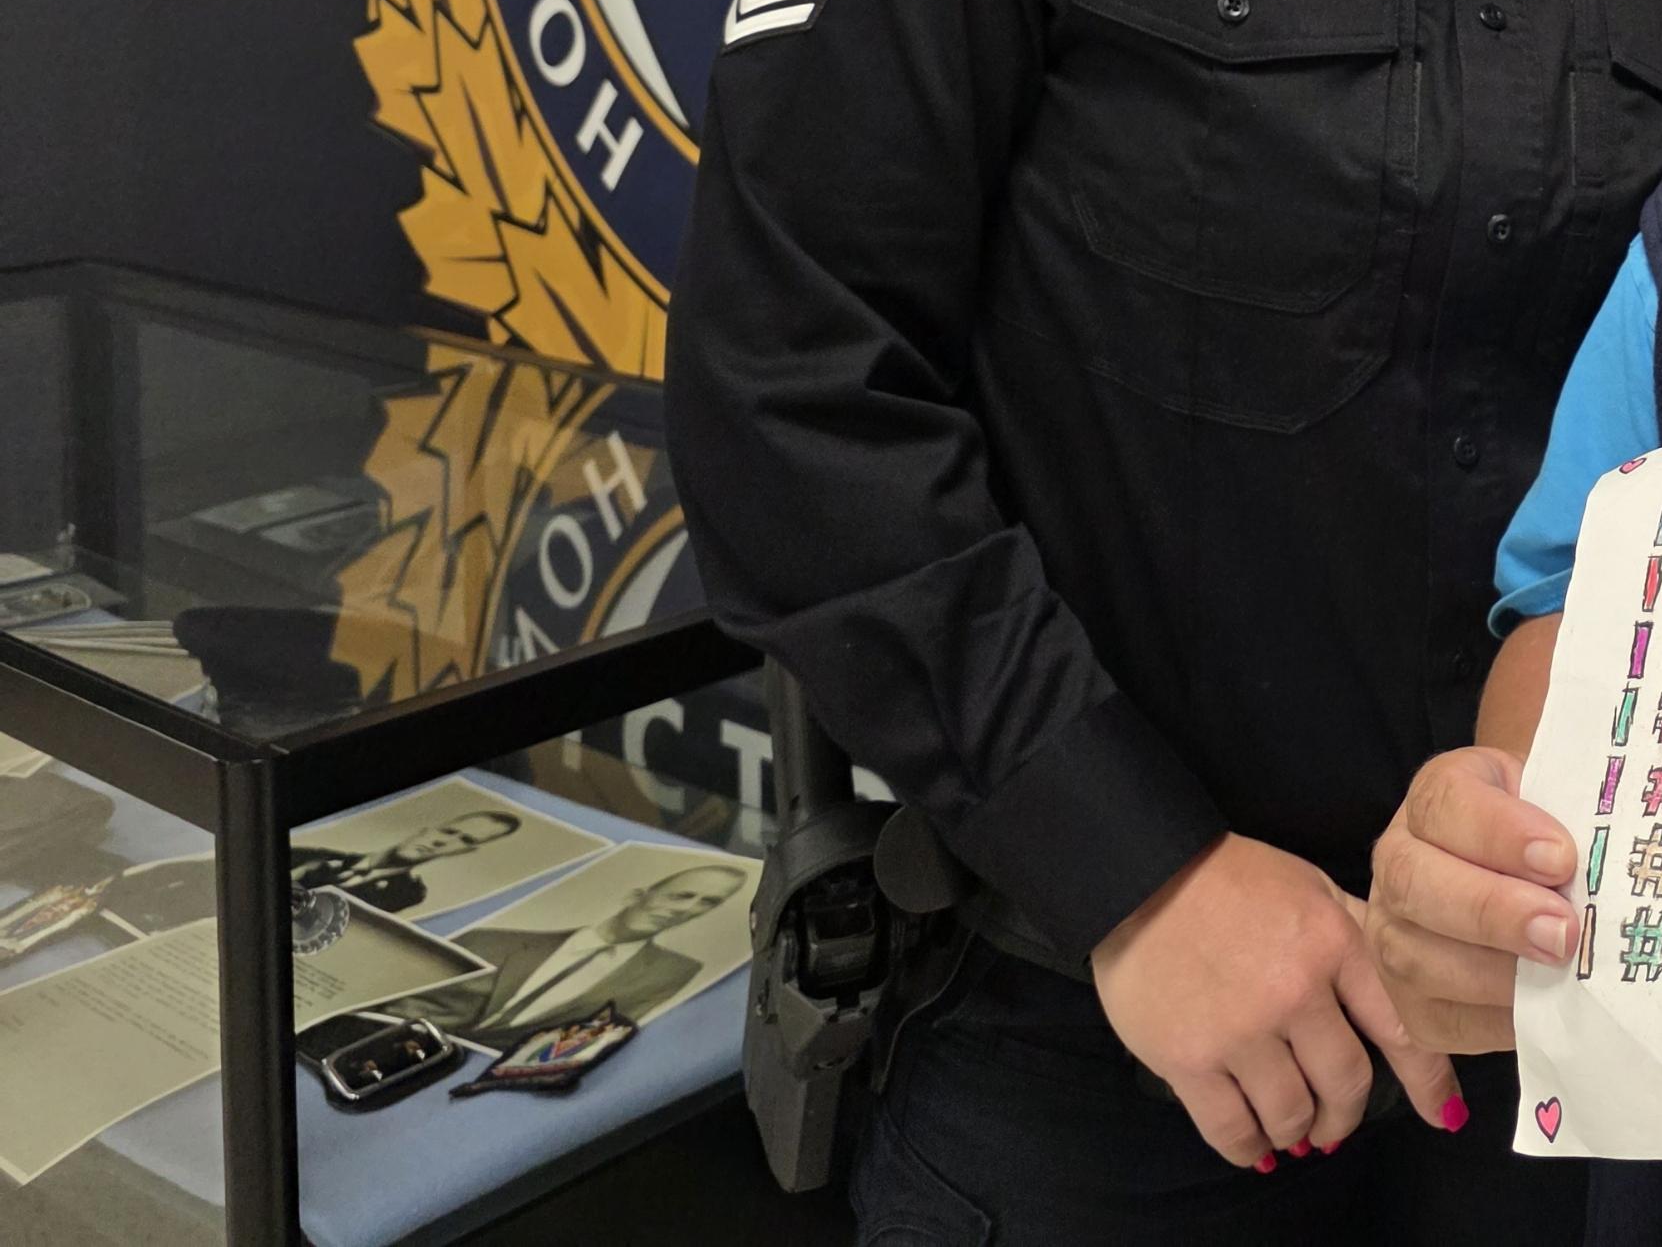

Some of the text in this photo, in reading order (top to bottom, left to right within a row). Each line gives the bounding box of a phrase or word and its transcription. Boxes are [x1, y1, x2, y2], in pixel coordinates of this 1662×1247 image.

[1627, 620, 1654, 679] I
[1611, 685, 1640, 747] I
[1596, 755, 1626, 816] I
[1586, 825, 1610, 896] I
[1576, 903, 1597, 981] I
